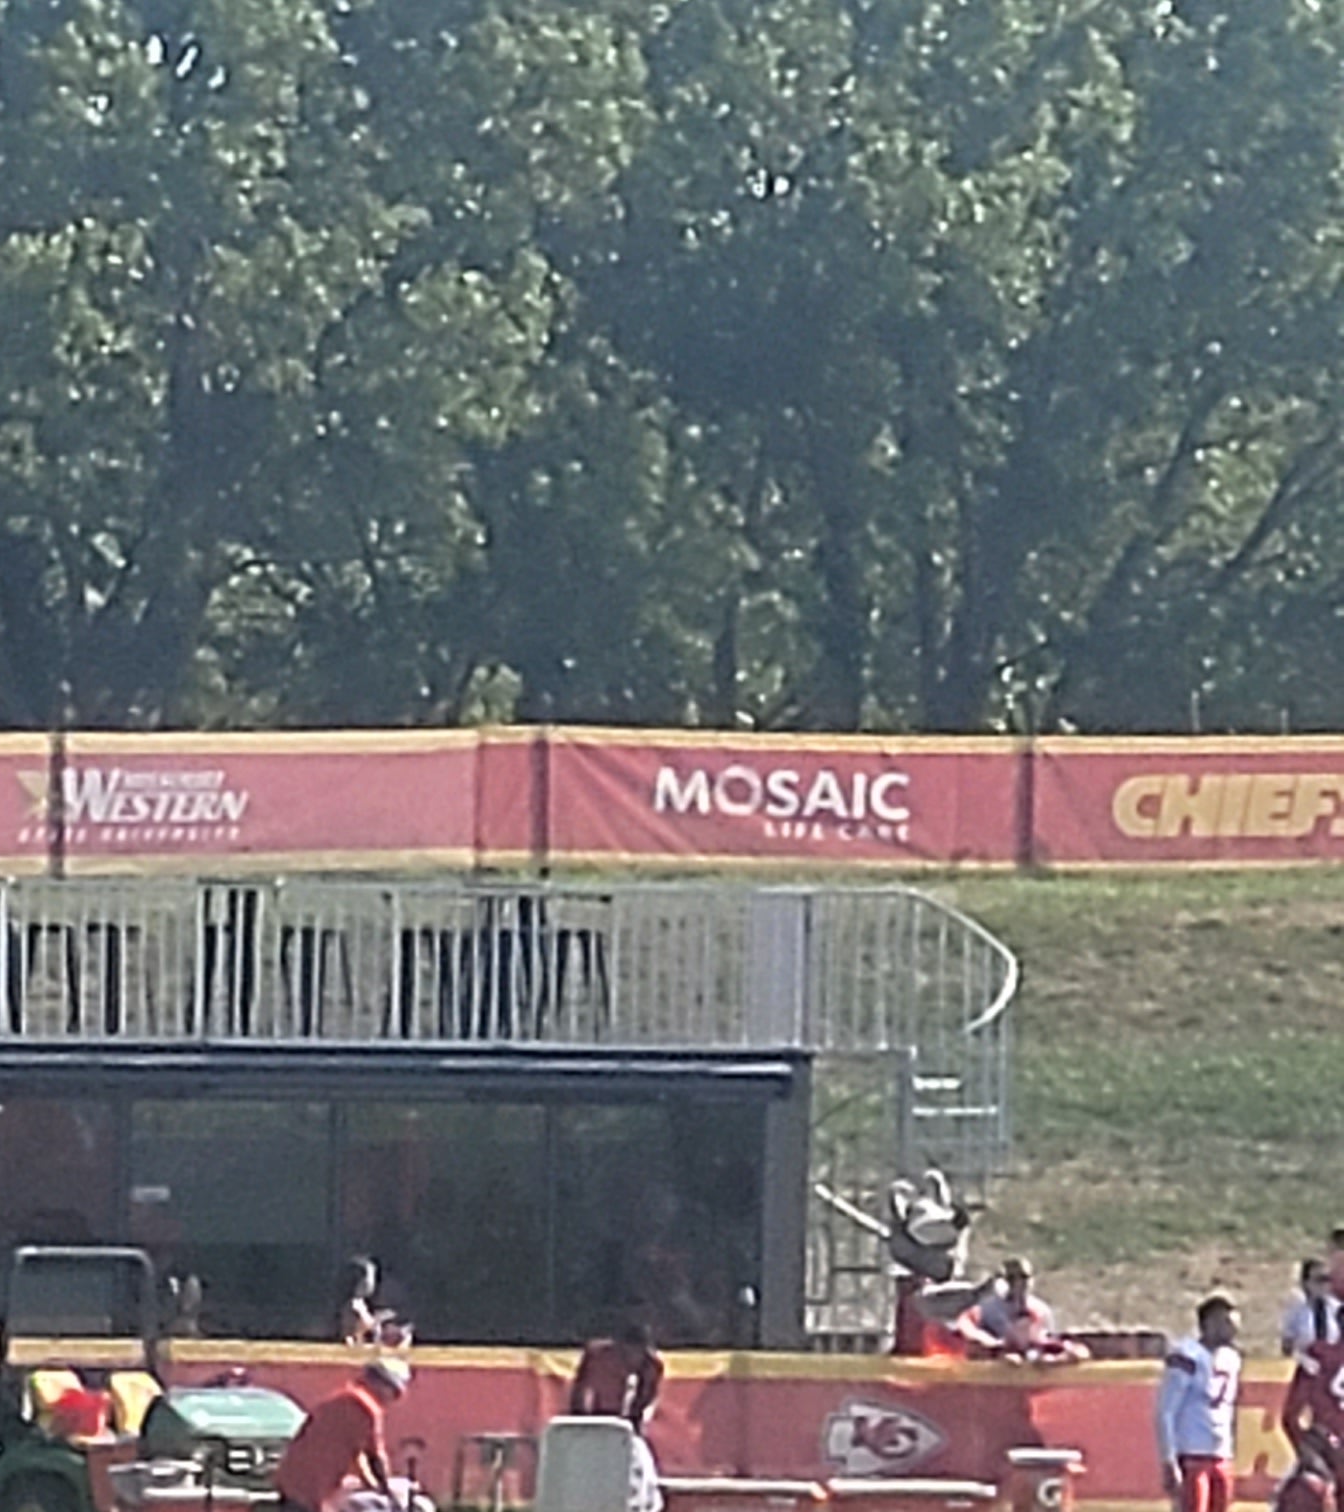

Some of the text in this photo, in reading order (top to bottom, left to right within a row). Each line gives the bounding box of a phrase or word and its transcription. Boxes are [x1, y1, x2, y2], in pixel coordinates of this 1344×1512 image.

[61, 766, 250, 824] WESTERN
[654, 764, 912, 822] MOSAIC
[1112, 772, 1344, 839] CHIEF
